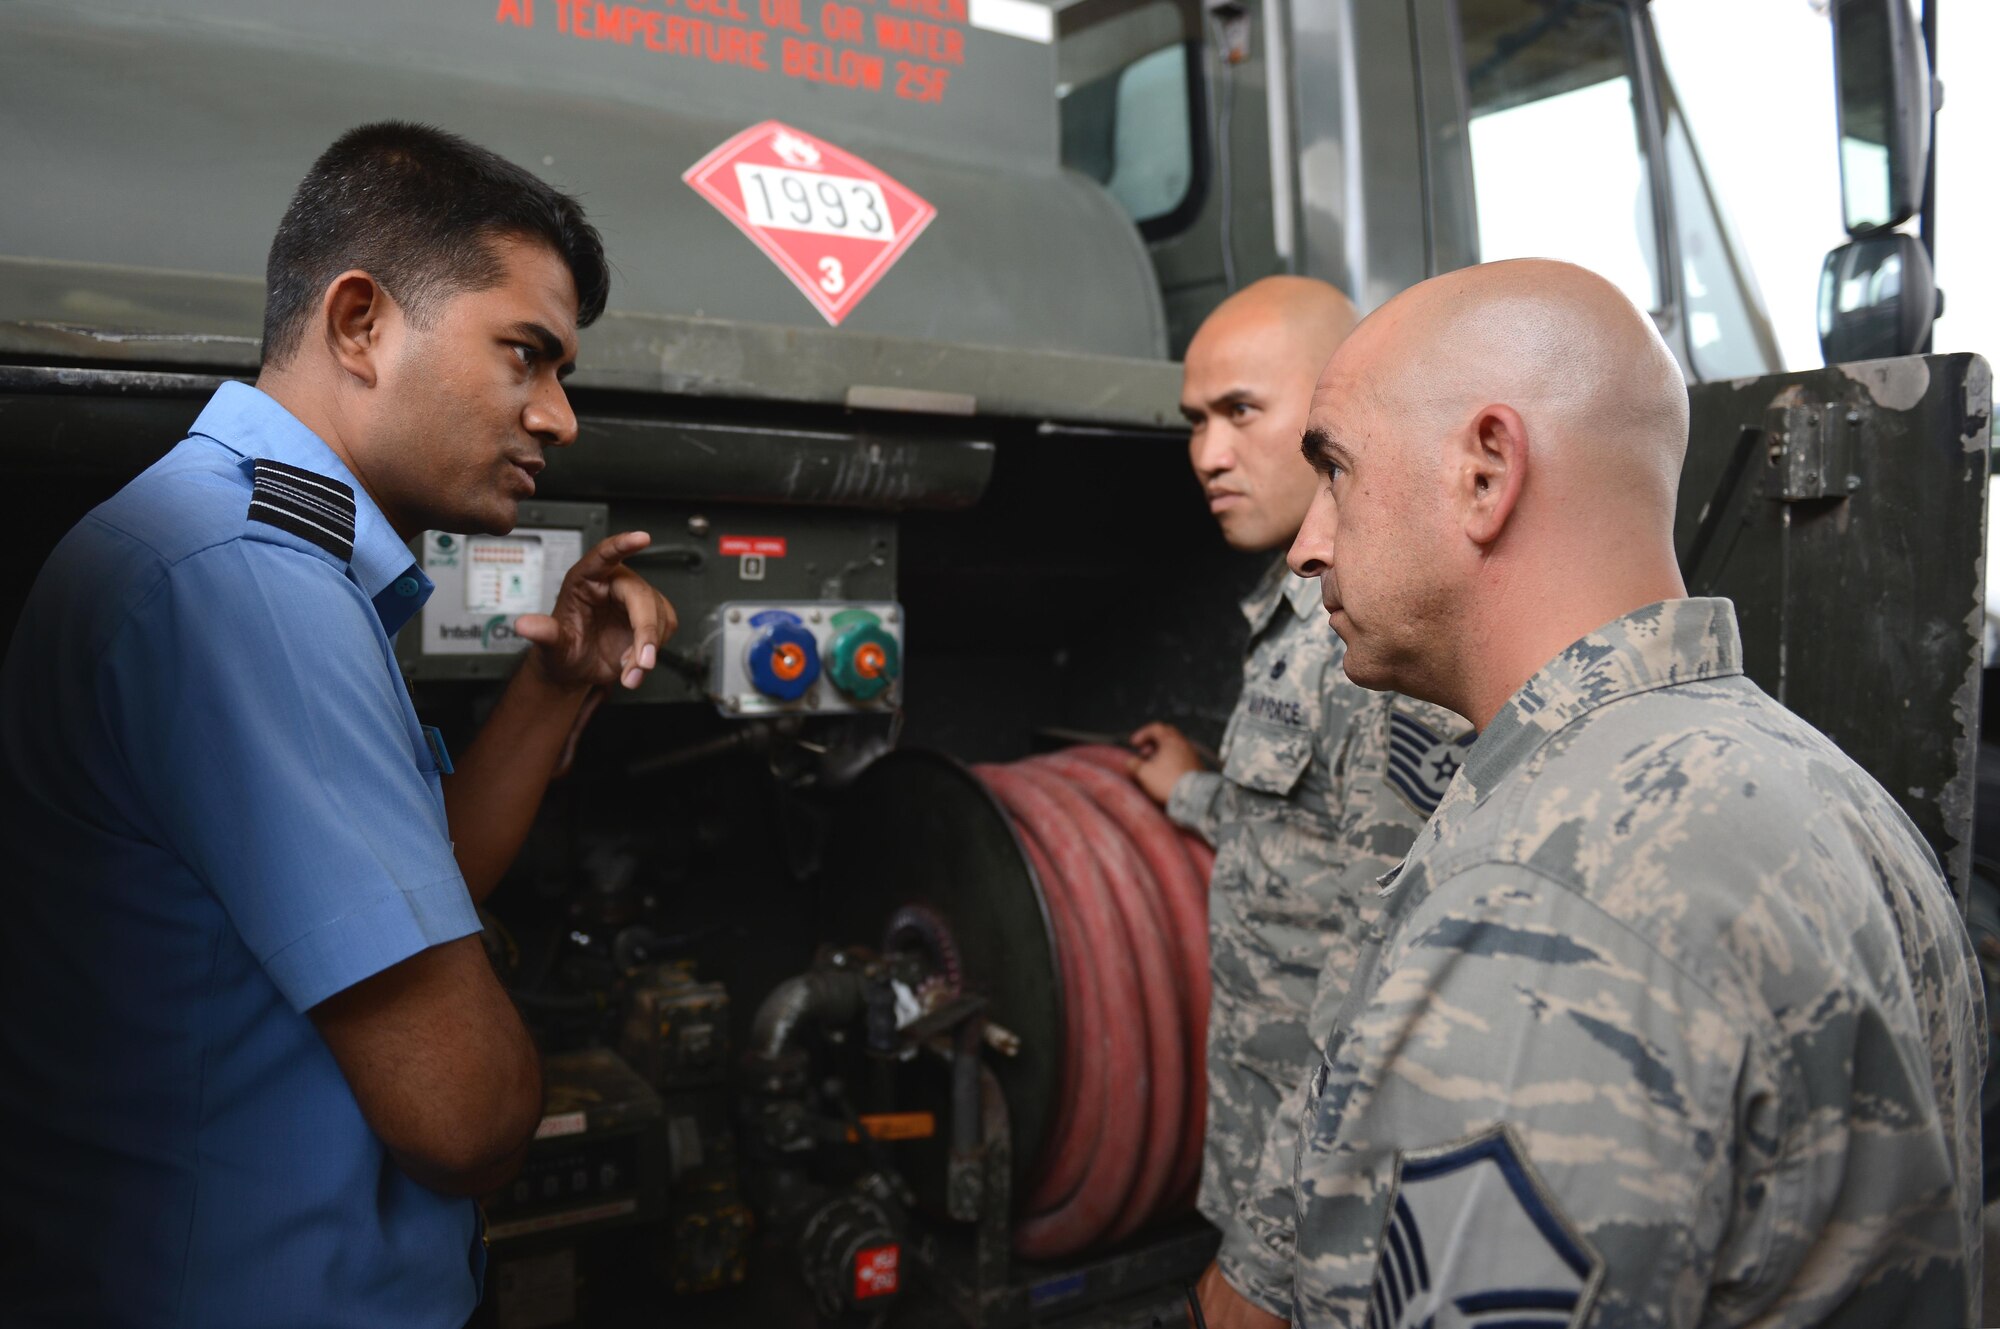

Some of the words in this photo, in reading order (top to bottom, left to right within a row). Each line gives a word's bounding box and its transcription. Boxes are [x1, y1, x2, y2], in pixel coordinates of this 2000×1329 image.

[555, 0, 769, 71] TEMPERTURE
[782, 37, 885, 91] BELOW
[895, 60, 950, 103] 25F
[820, 2, 864, 45] OR
[874, 13, 964, 64] WATER
[751, 173, 883, 234] 1993
[818, 256, 846, 294] 3
